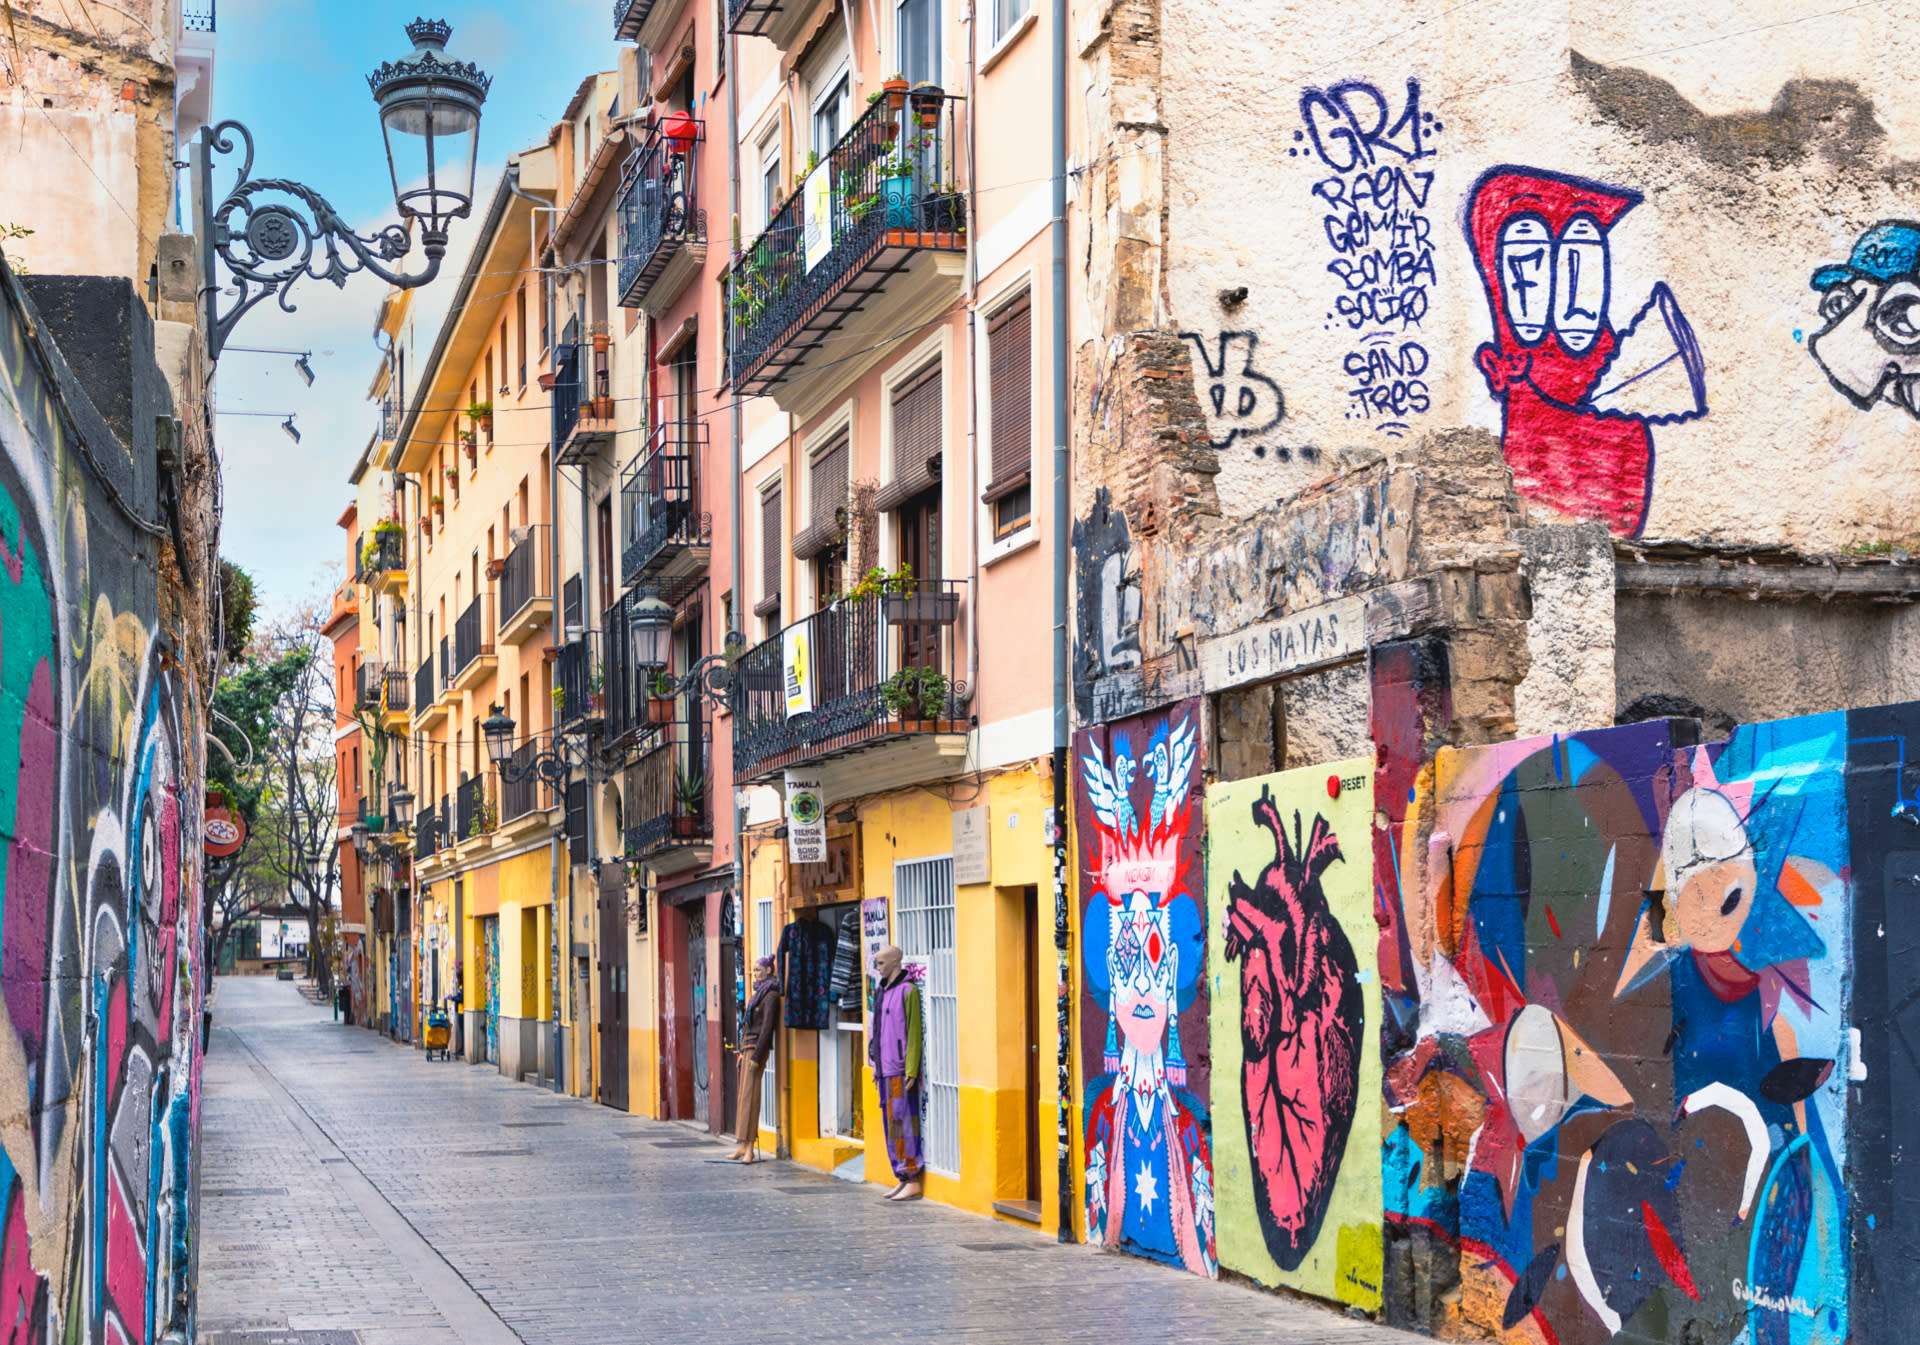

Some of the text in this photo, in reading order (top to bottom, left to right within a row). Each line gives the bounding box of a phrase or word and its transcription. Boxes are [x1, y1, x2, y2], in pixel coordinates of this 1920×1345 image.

[1327, 248, 1436, 290] BOMBA
[1344, 342, 1429, 386] SAND
[786, 781, 822, 789] TAMALA
[1341, 776, 1367, 791] RESET
